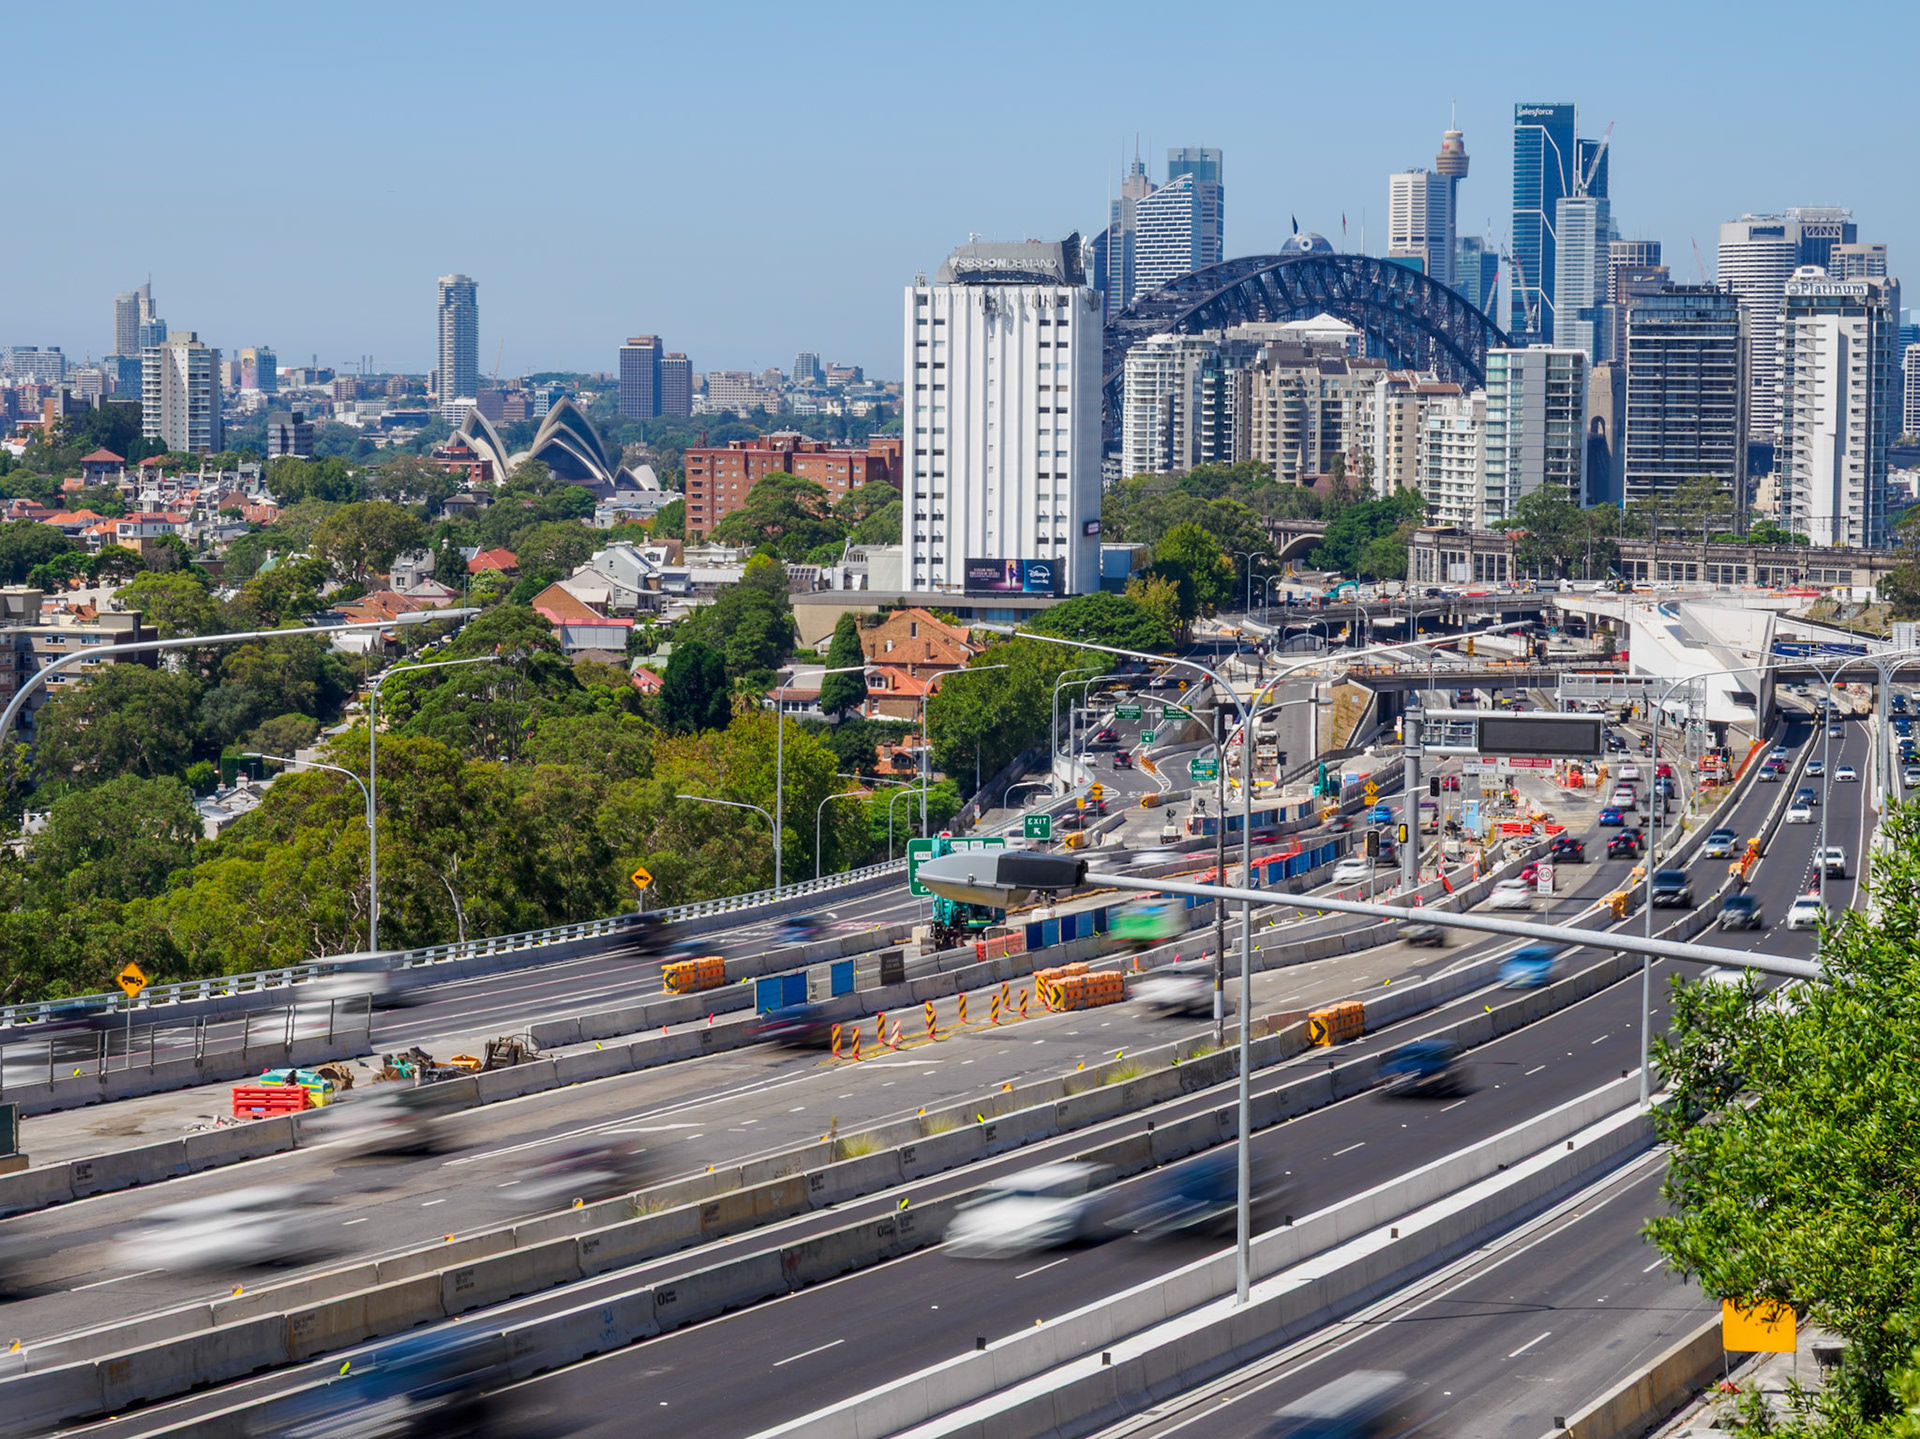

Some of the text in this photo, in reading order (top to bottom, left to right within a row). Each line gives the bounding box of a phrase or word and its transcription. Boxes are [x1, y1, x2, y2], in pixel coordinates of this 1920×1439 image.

[1517, 108, 1554, 117] salesforce
[958, 258, 983, 268] SBS
[1801, 283, 1865, 295] Platinum
